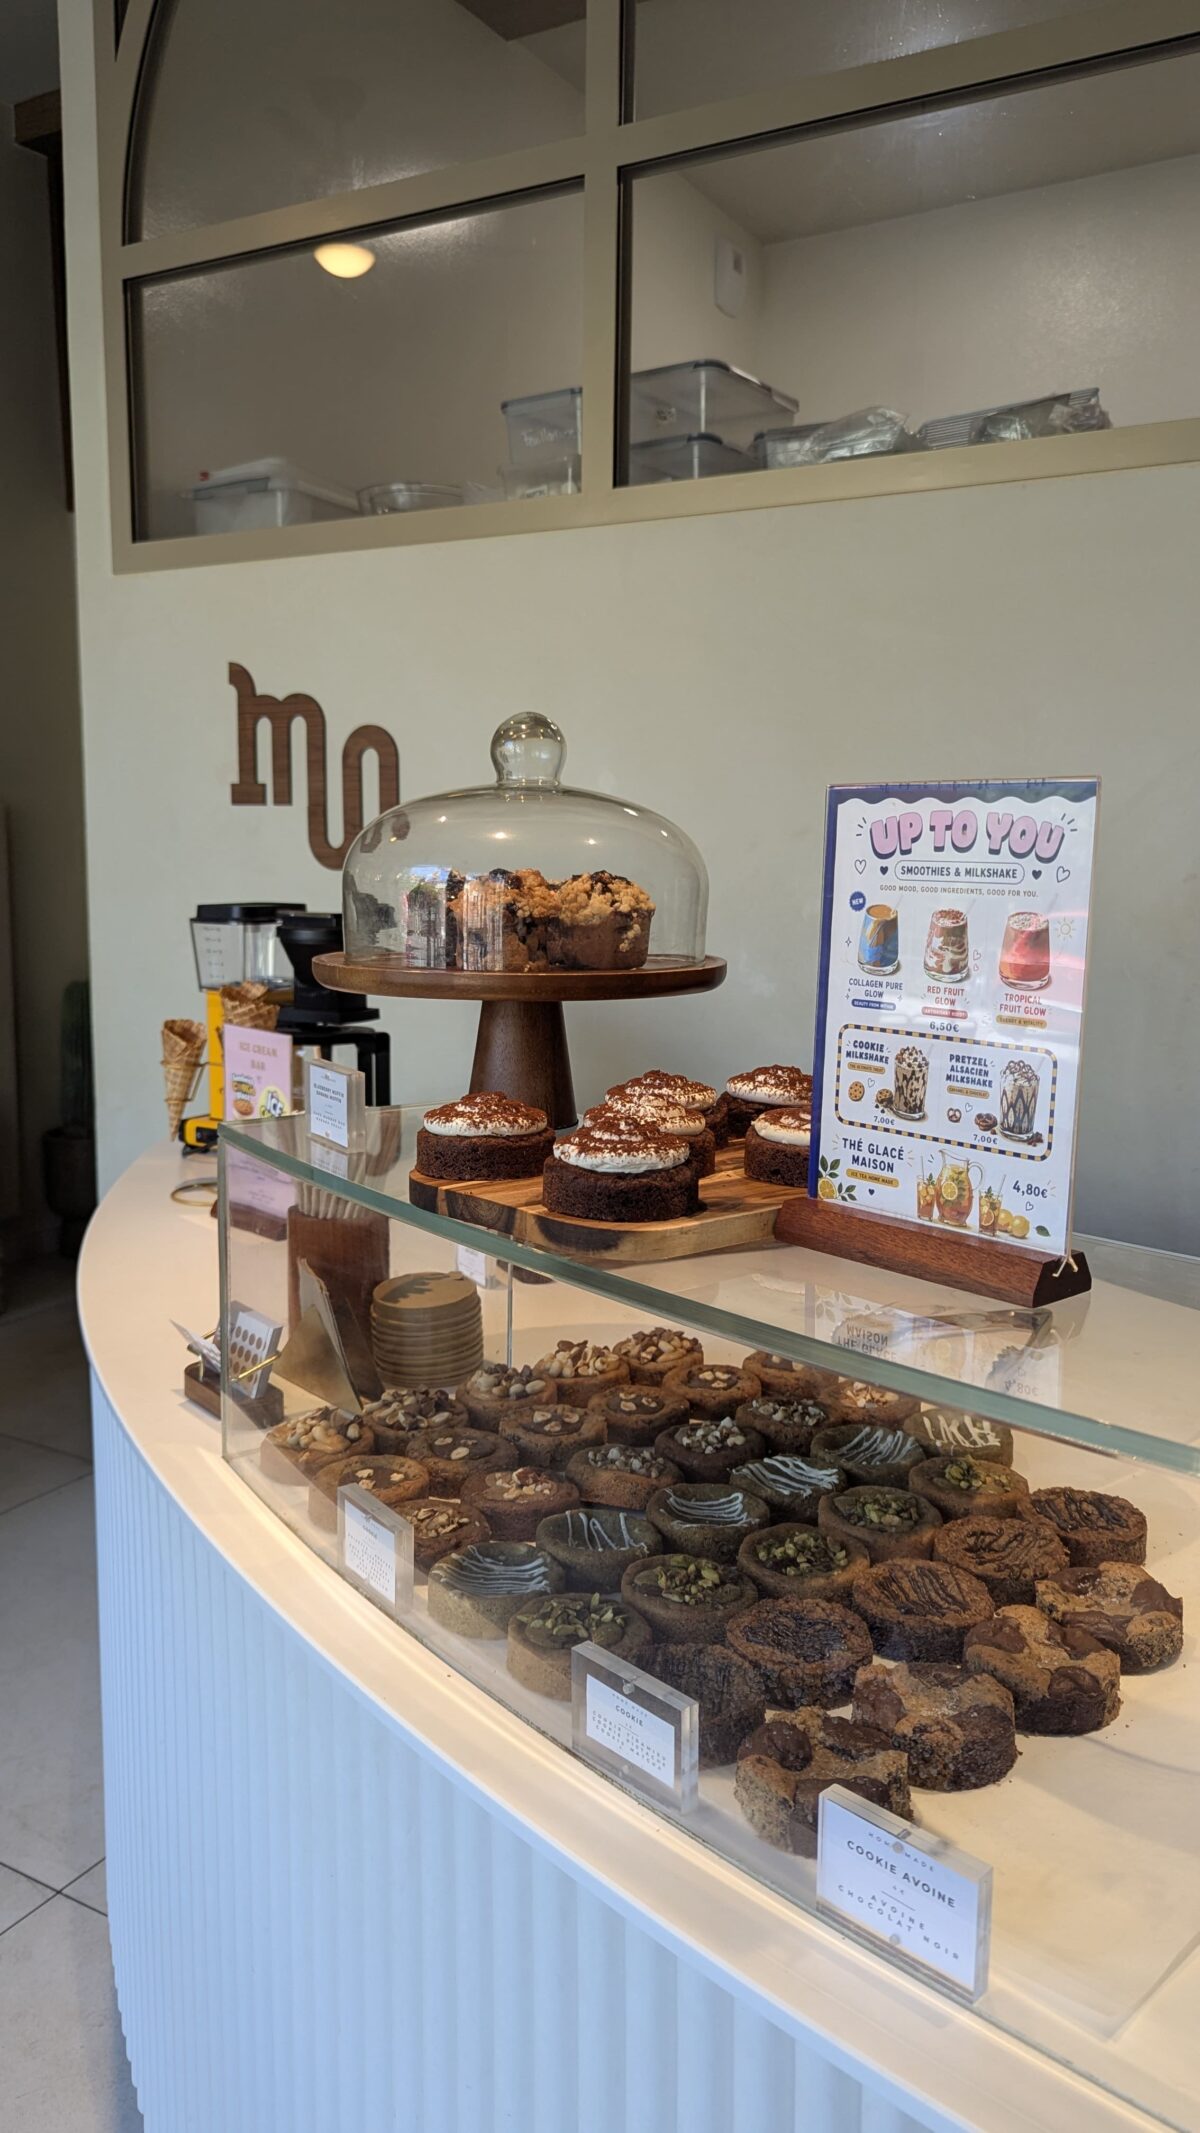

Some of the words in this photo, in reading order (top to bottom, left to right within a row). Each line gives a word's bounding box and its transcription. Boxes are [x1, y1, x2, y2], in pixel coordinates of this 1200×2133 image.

[870, 812, 923, 859] UP
[930, 810, 978, 852] TO
[986, 812, 1065, 863] YOU
[900, 865, 950, 877] SMOOTHIES
[954, 867, 961, 877] &
[964, 867, 1018, 879] MILKSHAKE
[880, 884, 897, 892] GOOD
[899, 885, 919, 893] MOOD,
[940, 887, 984, 896] INGREDIENTS,
[1008, 889, 1021, 897] FOR
[848, 978, 883, 988] COLLAGEN
[885, 981, 903, 990] PURE
[864, 989, 884, 999] GLOW
[927, 985, 941, 994] RED
[943, 986, 965, 997] FRUIT
[934, 996, 956, 1006] GLOW
[1004, 993, 1042, 1005] TROPICAL
[999, 1003, 1021, 1013] FRUIT
[1023, 1006, 1046, 1016] GLOW
[929, 1021, 959, 1033] 6,50€
[852, 1040, 885, 1053] COOKIE
[845, 1051, 890, 1065] MILKSHAKE
[949, 1054, 989, 1067] PRETZEL
[949, 1064, 989, 1077] ALSACIEN
[945, 1074, 993, 1088] MILKSHAKE
[873, 1115, 896, 1126] 7,00€
[973, 1134, 998, 1145] 7,00€
[842, 1137, 863, 1151] THÉ
[868, 1143, 904, 1160] GLACÉ
[851, 1154, 894, 1173] MAISON
[1012, 1180, 1048, 1199] 4,80€
[615, 1704, 644, 1727] COOKIE
[904, 1852, 934, 1872] MADE
[847, 1840, 897, 1874] COOKIE
[902, 1872, 956, 1908] AVOINE
[871, 1895, 925, 1930] AVOINE
[838, 1884, 912, 1932] CHOCOLAT
[923, 1935, 959, 1960] NOIR
